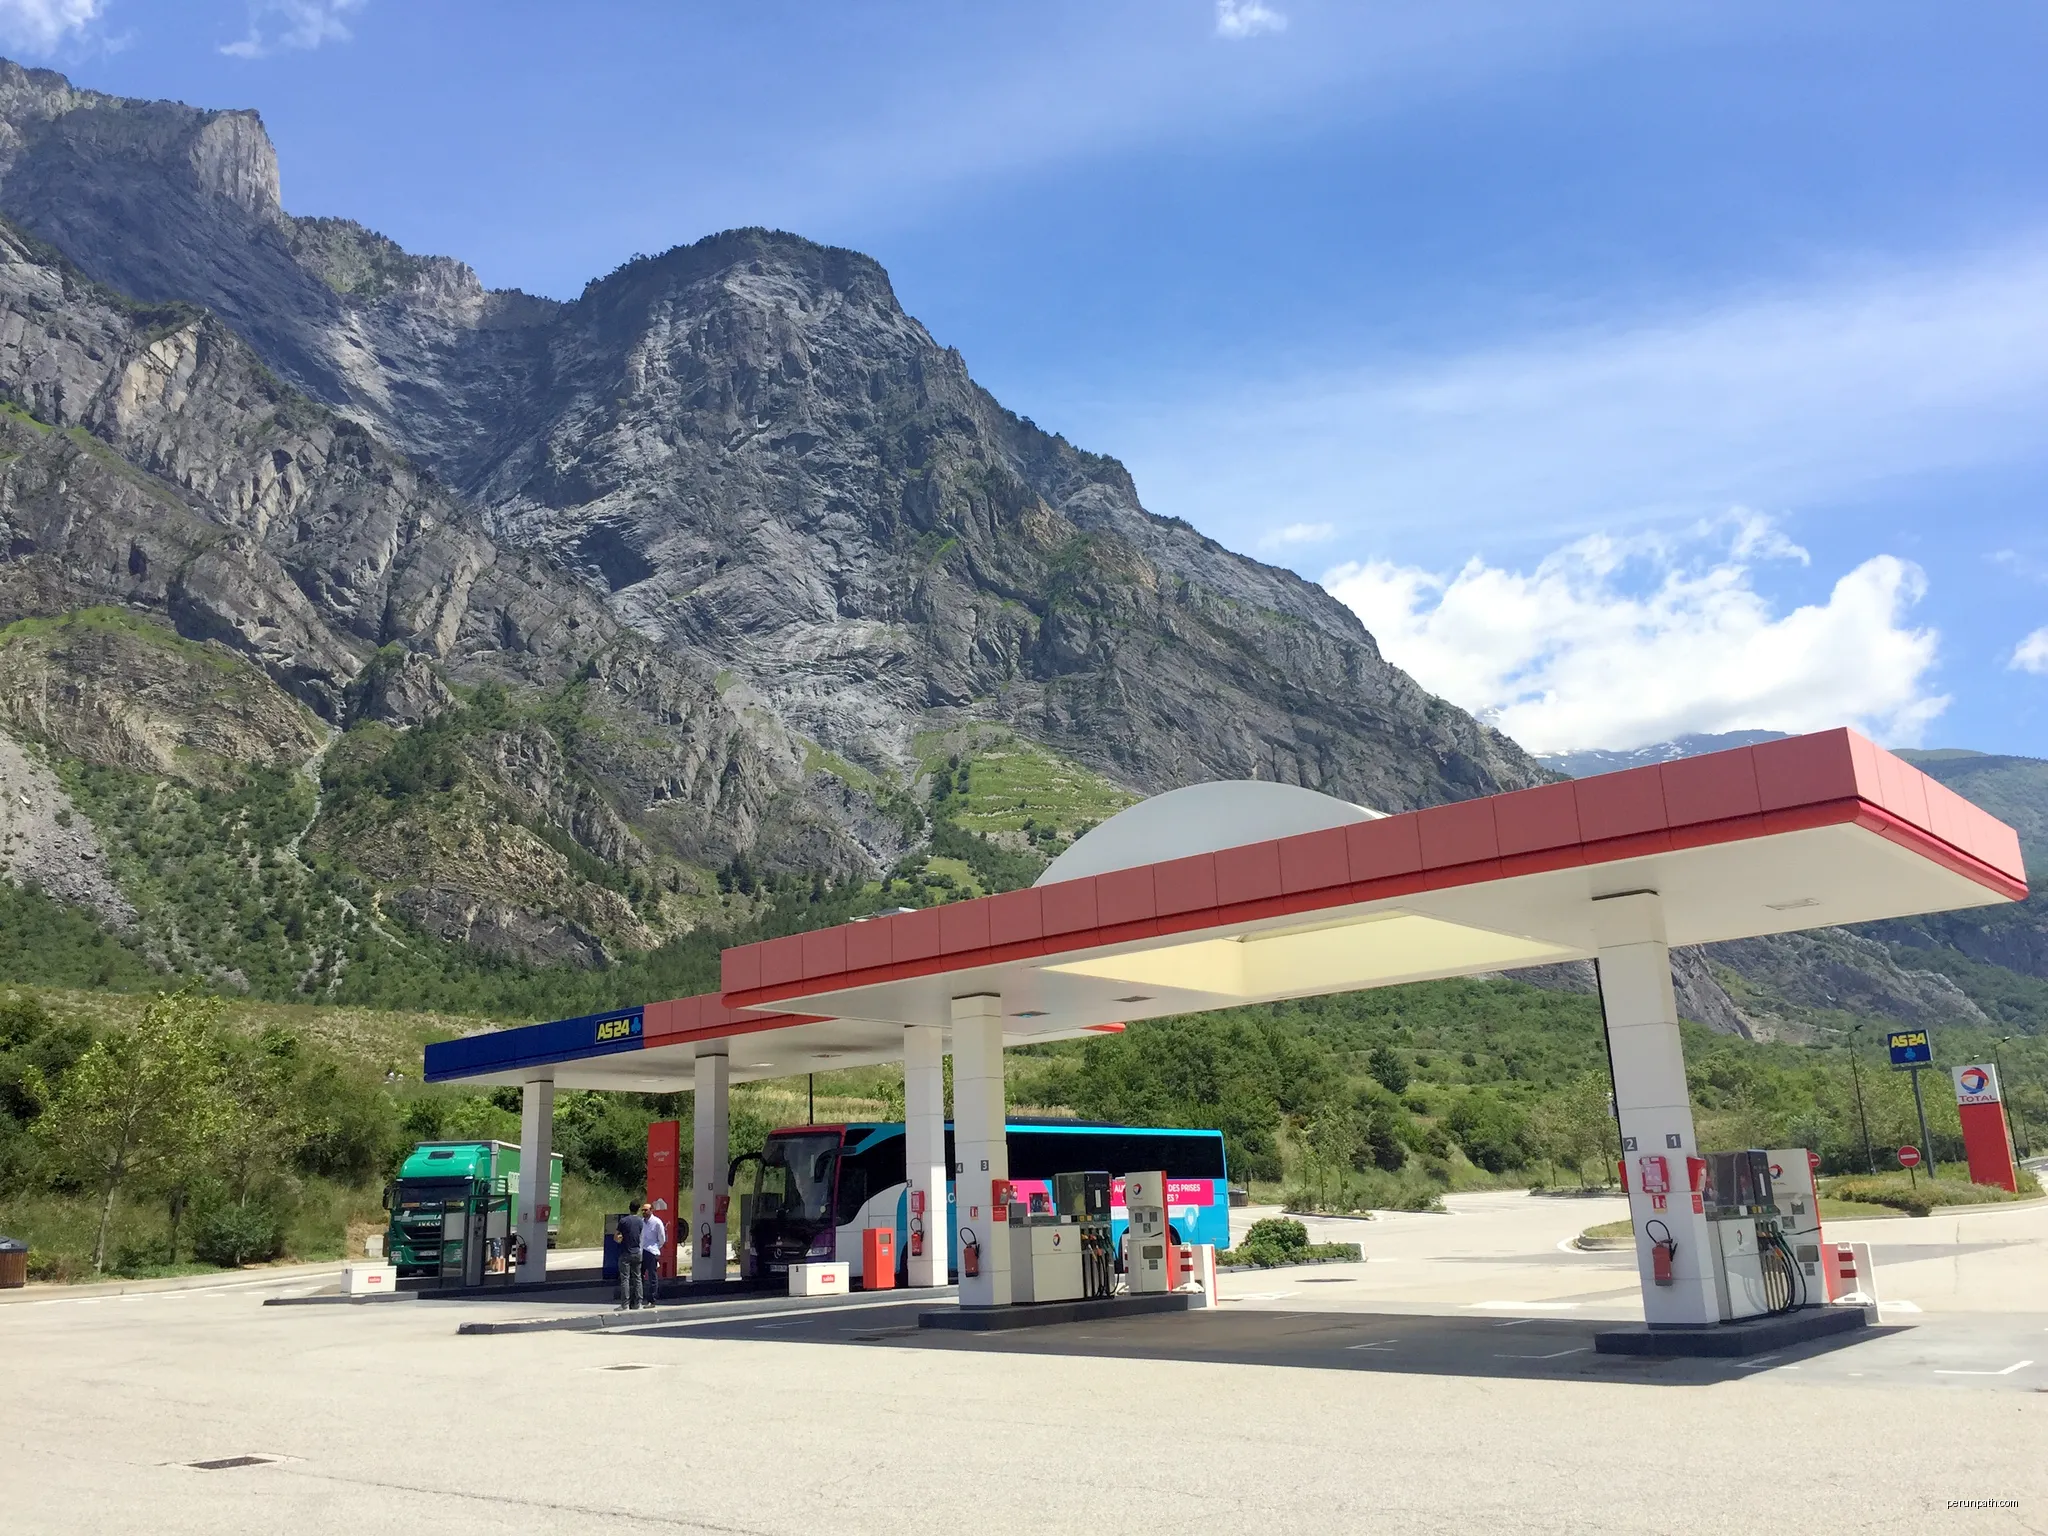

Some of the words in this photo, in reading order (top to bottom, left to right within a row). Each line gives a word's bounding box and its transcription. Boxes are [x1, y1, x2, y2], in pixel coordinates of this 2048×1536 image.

[1958, 1094, 1997, 1103] TOTAL
[1626, 1139, 1635, 1150] 2
[1671, 1136, 1678, 1147] 1
[1168, 1184, 1180, 1192] DES
[1181, 1183, 1201, 1192] PRISES
